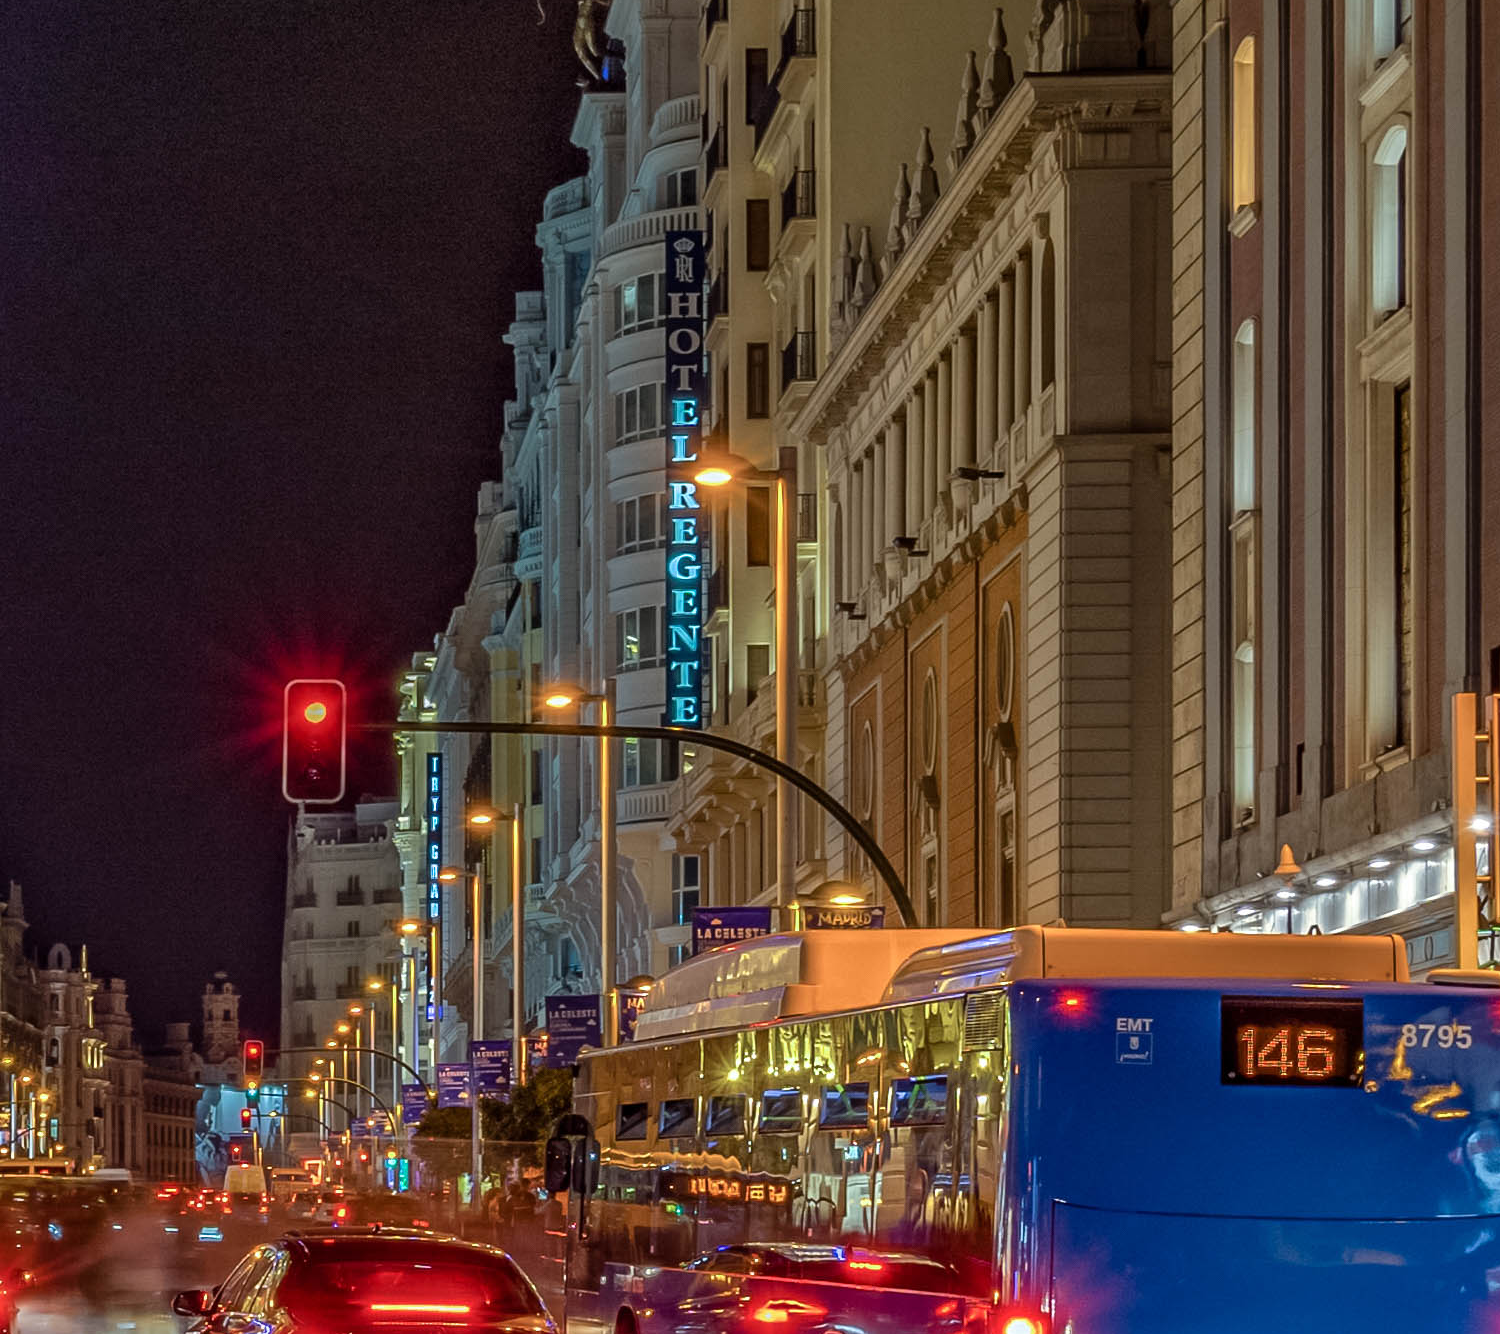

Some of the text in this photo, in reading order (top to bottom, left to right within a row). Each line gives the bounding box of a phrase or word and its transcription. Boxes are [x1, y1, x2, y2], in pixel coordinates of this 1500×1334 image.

[667, 292, 701, 463] HOTEL
[667, 481, 702, 723] REGENTE
[818, 912, 872, 927] MADRID
[697, 928, 767, 939] LA CELESTE
[1116, 1017, 1153, 1032] EMT
[1401, 1024, 1472, 1049] 8795
[1241, 1029, 1335, 1076] 146
